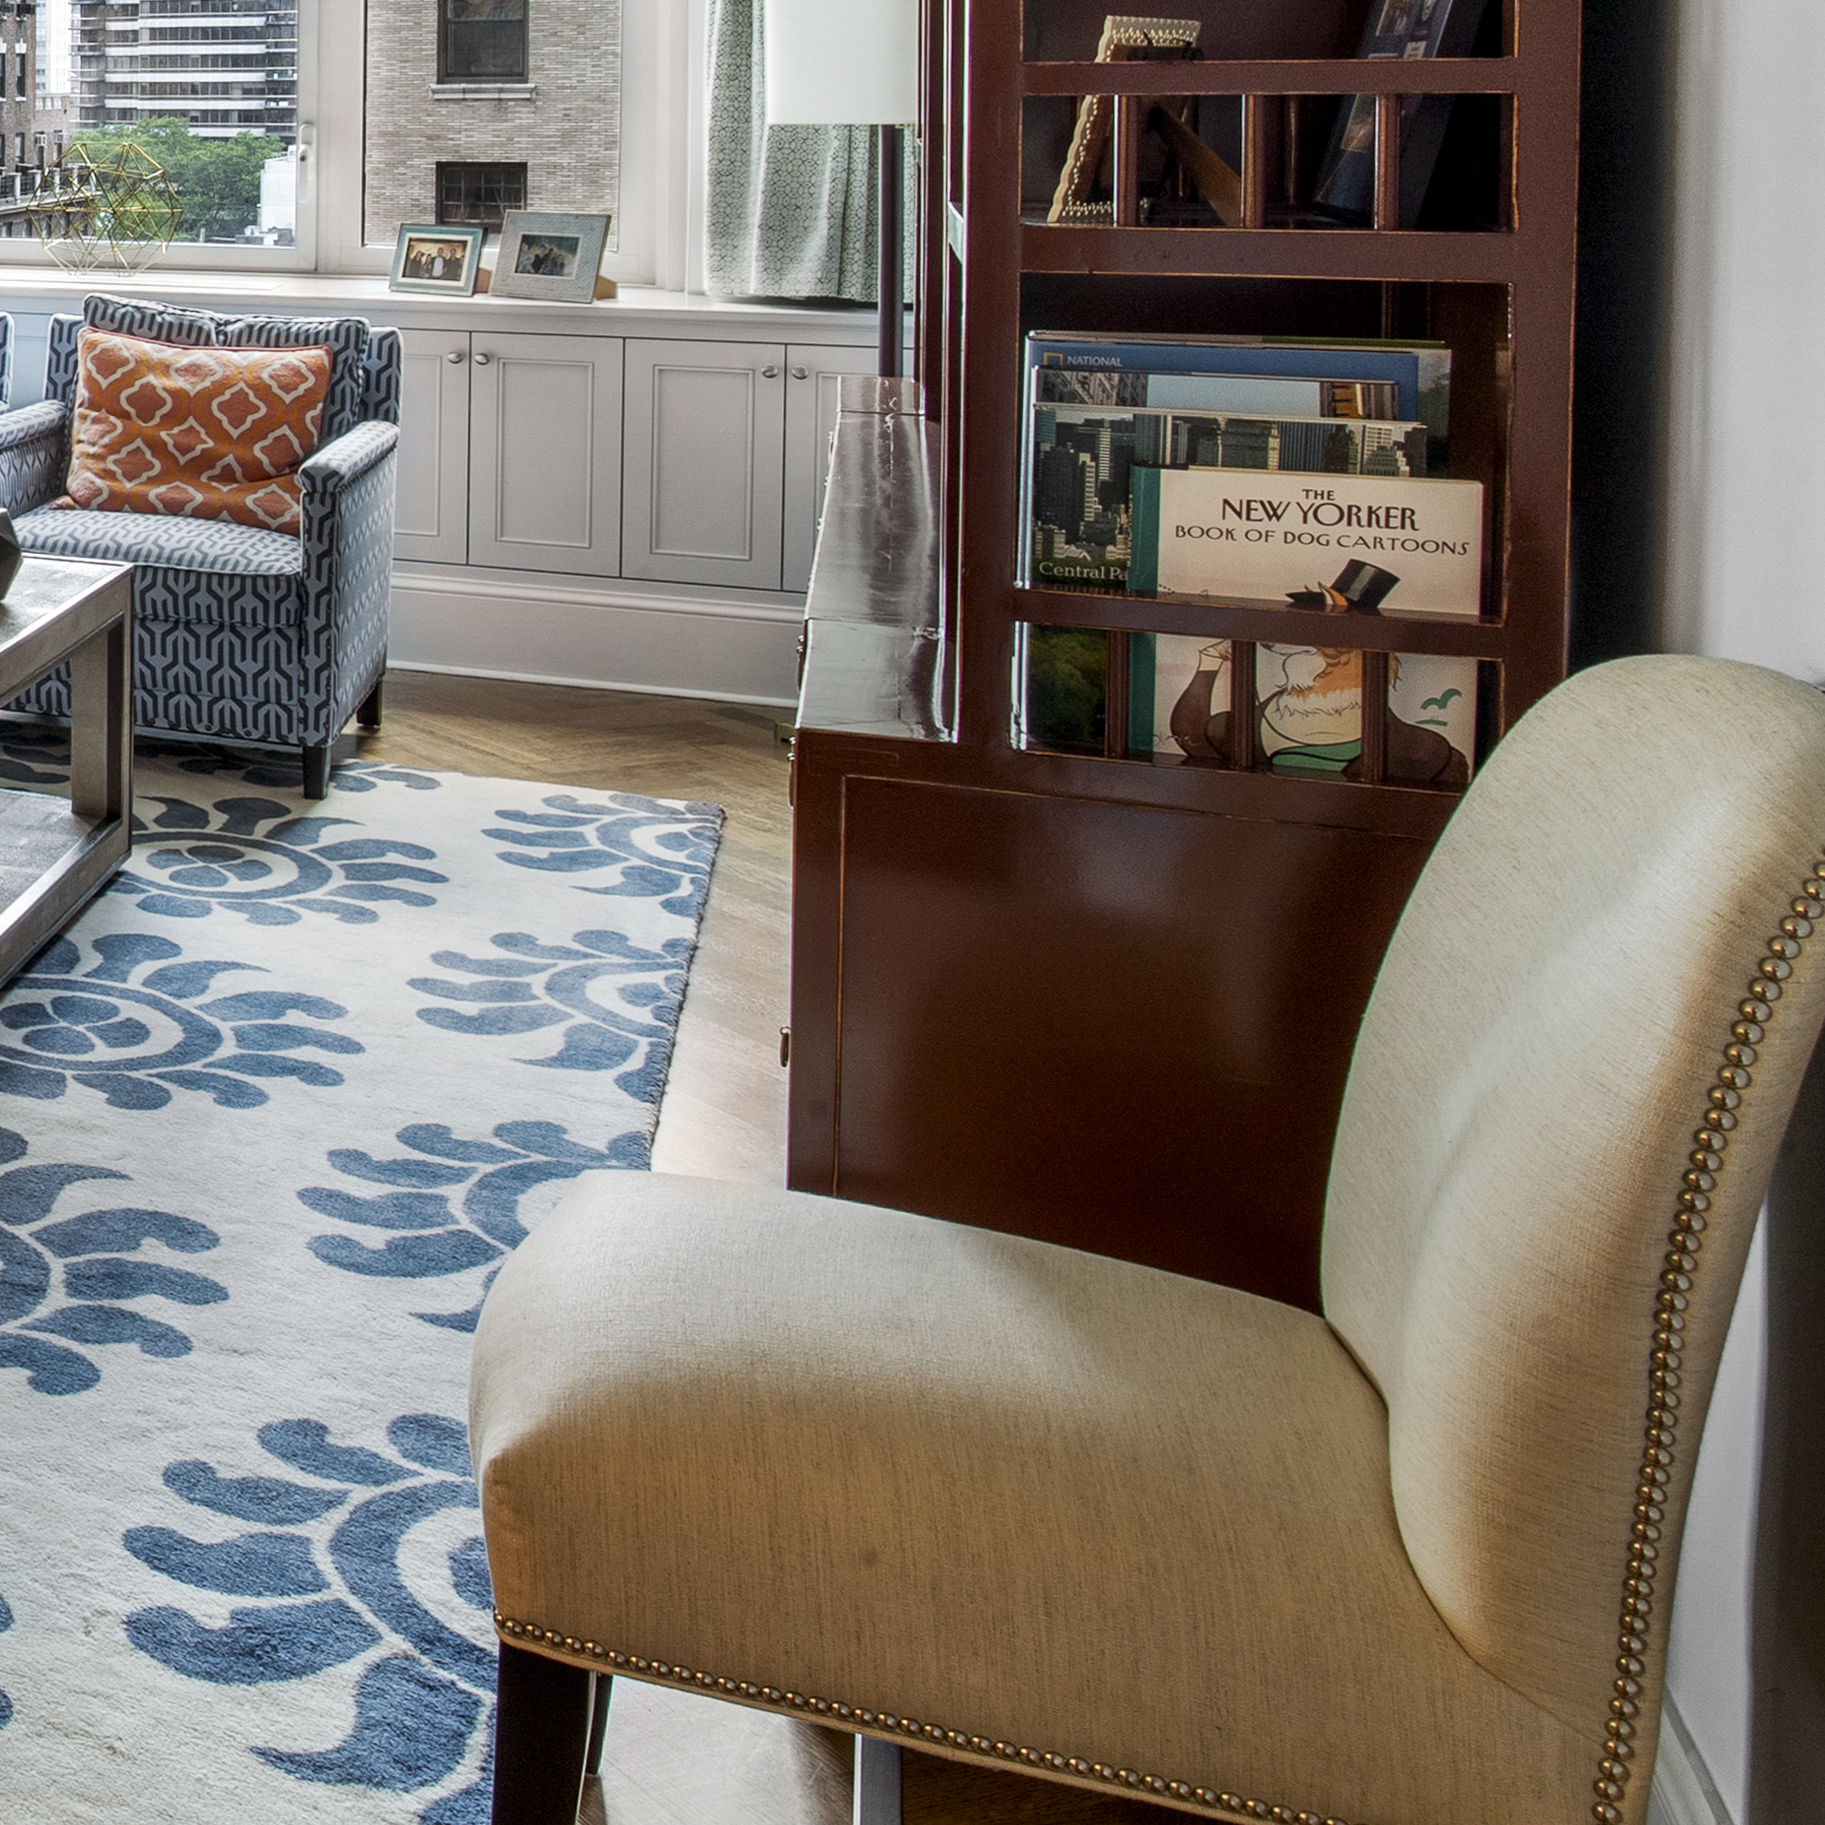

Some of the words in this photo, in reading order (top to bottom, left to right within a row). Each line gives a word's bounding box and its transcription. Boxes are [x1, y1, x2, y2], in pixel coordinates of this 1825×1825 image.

[1067, 355, 1123, 368] NATIONAL
[1302, 488, 1336, 502] THE
[1221, 498, 1291, 523] NEW
[1296, 501, 1421, 532] YORKER
[1175, 525, 1237, 542] BOOK
[1244, 528, 1277, 544] OF
[1283, 530, 1331, 548] DOG
[1336, 534, 1471, 557] CARTOONS
[1039, 561, 1106, 580] Central
